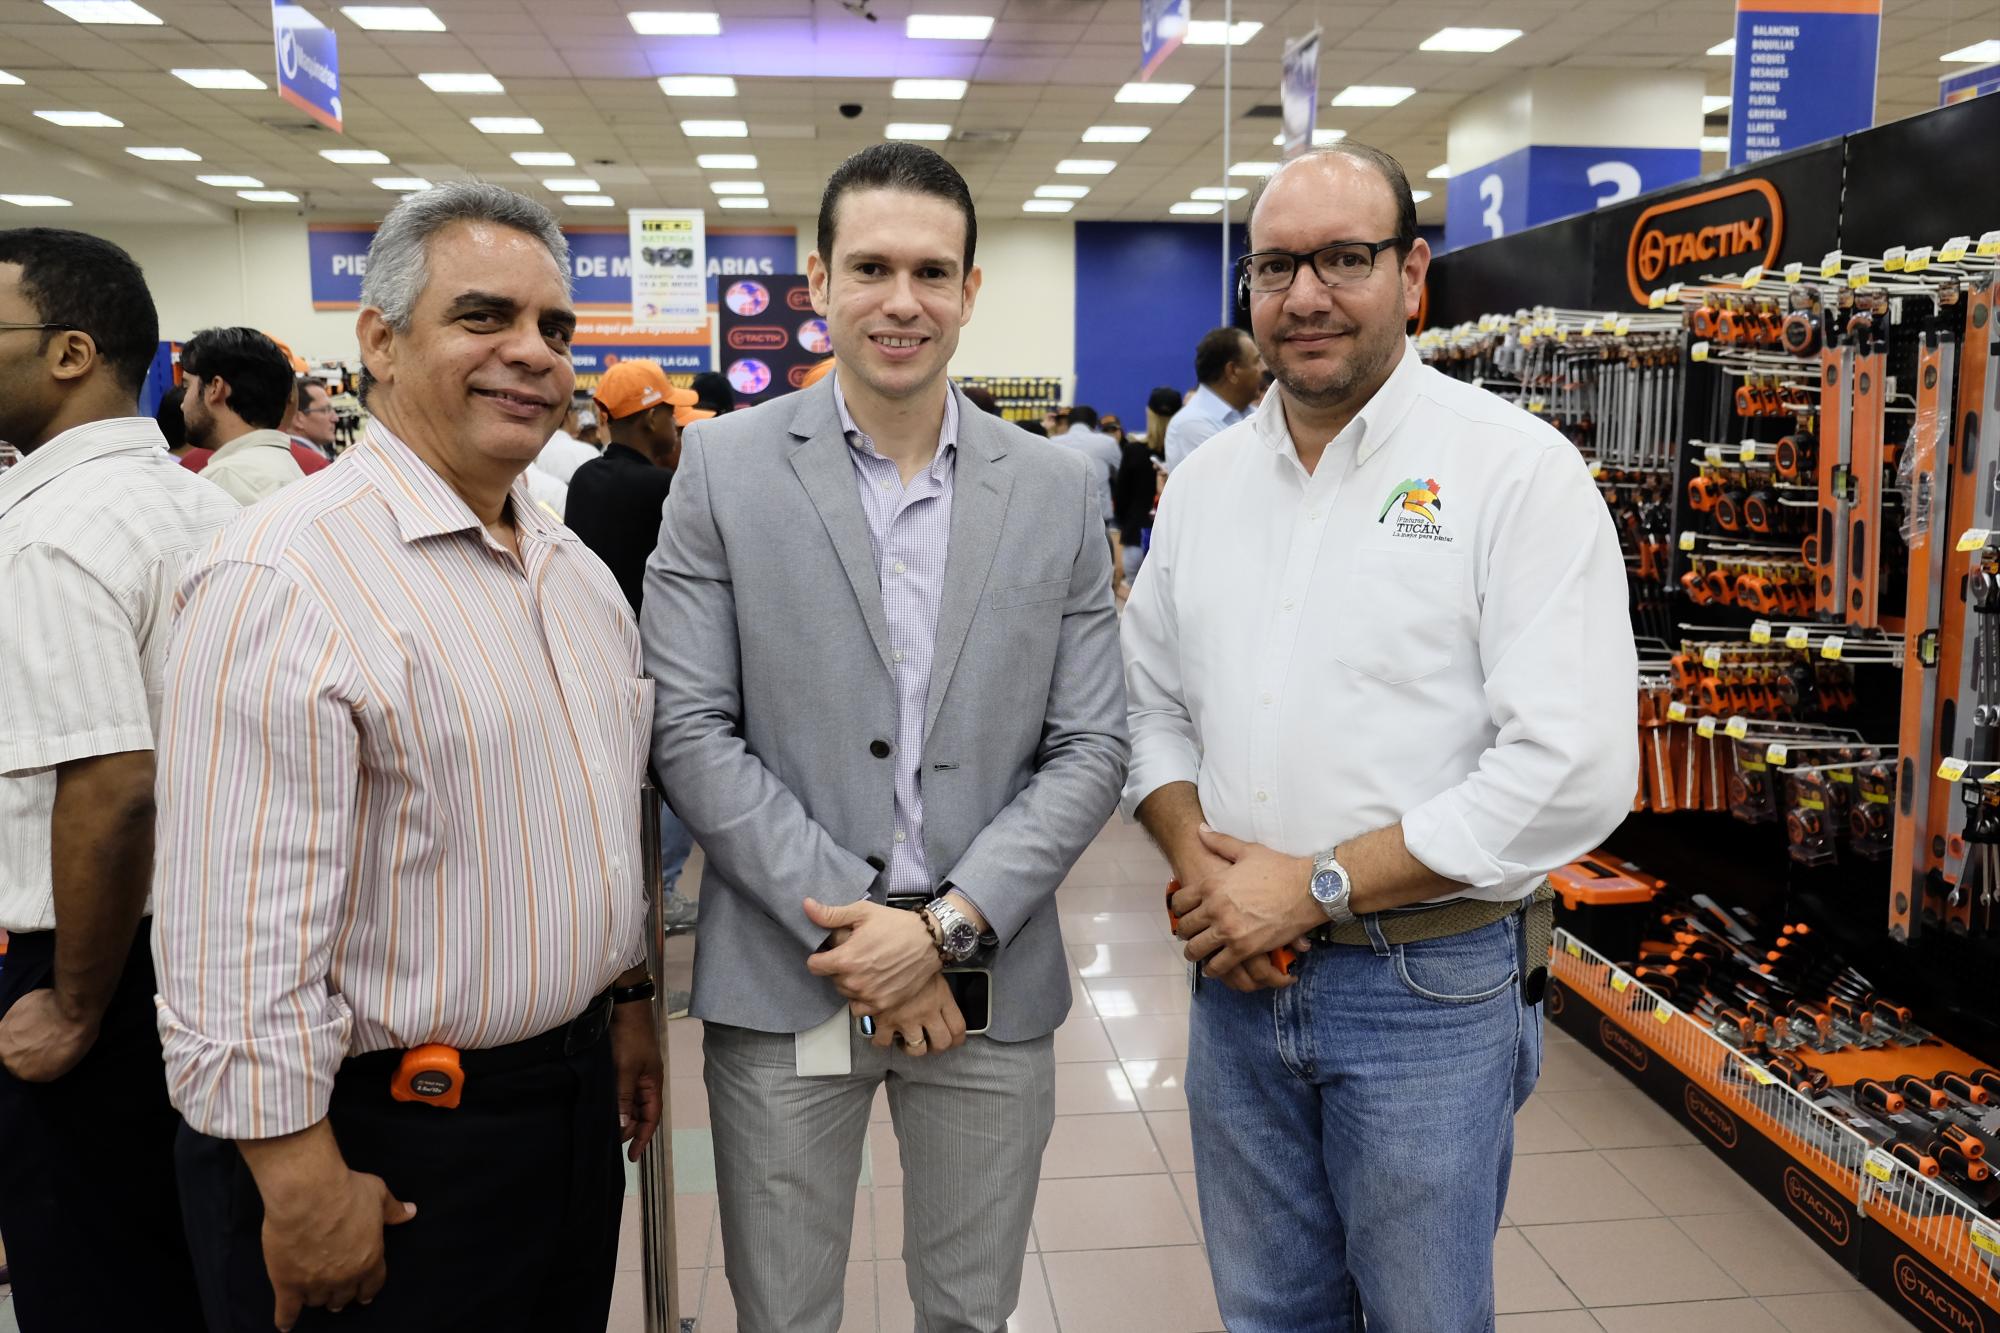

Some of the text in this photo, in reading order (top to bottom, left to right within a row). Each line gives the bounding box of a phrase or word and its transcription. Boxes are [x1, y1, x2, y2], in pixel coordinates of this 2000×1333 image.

[1752, 25, 1800, 37] BALANCINES
[1751, 39, 1795, 51] BOQUILLAS
[1750, 53, 1786, 65] CHEQUES
[1749, 81, 1780, 92] DUCHAS
[1748, 95, 1777, 106] FLOTAS
[1746, 122, 1775, 134] LLAVES
[1746, 136, 1780, 148] REJILLAS
[1665, 217, 1764, 267] TACTIX
[575, 256, 607, 277] DE
[675, 356, 700, 367] CAJA
[1397, 522, 1442, 535] TUCÁN
[1434, 534, 1453, 542] pintar
[1801, 1190, 1842, 1232] TACTIX
[1916, 1279, 1975, 1333] TACTIX
